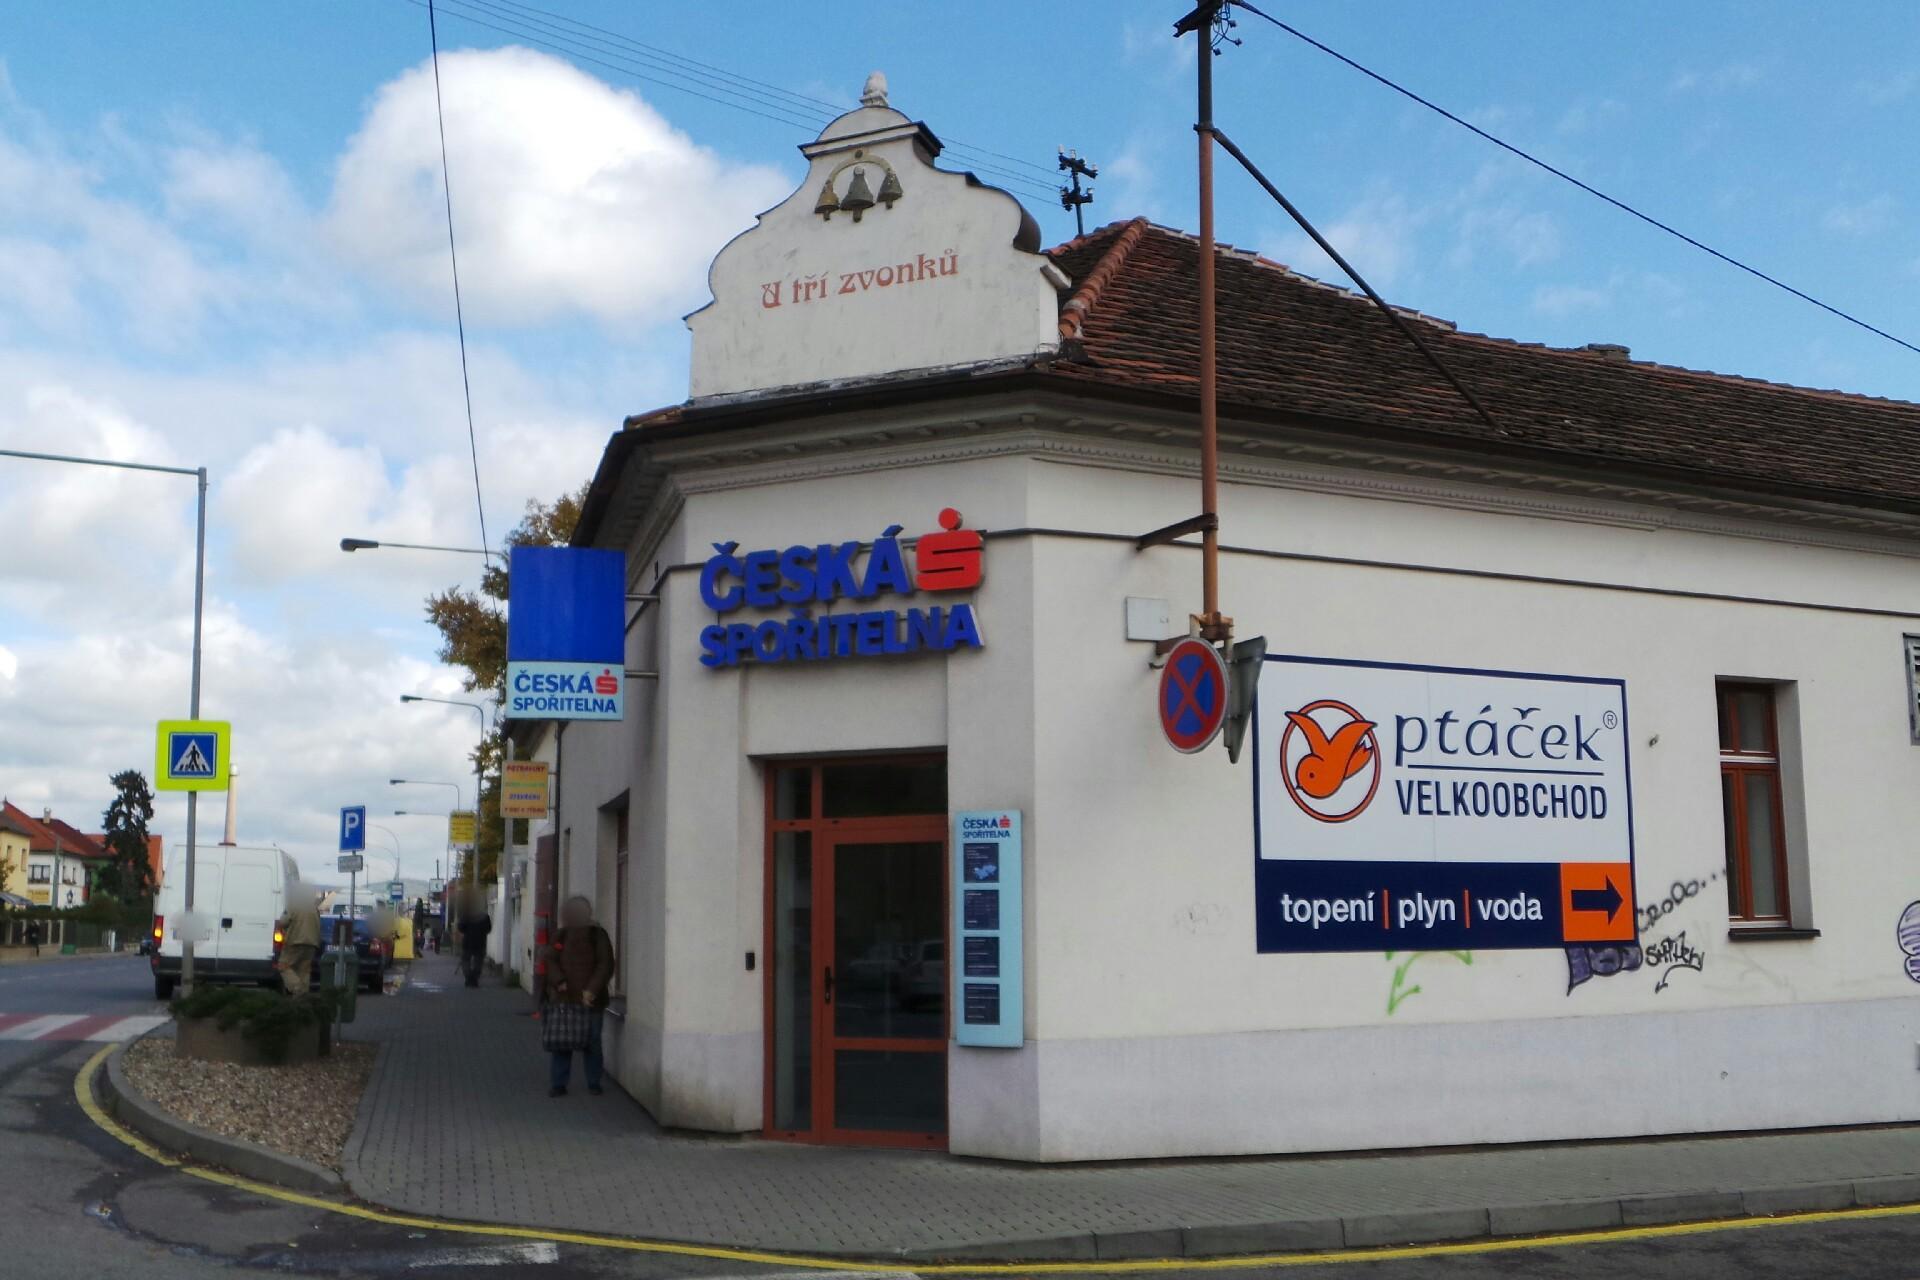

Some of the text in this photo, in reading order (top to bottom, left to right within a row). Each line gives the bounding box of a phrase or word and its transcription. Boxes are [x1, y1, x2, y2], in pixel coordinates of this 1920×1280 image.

[761, 248, 959, 309] U tří zvonků
[700, 525, 911, 613] ČESKÁ
[699, 603, 985, 668] SPOŘITELNA
[514, 669, 594, 693] ČESKÁ
[513, 694, 617, 713] SPOŘITELNA
[1395, 779, 1608, 820] VELKOOBCHOD
[344, 812, 359, 838] P
[1281, 891, 1544, 930] topení plyn voda
